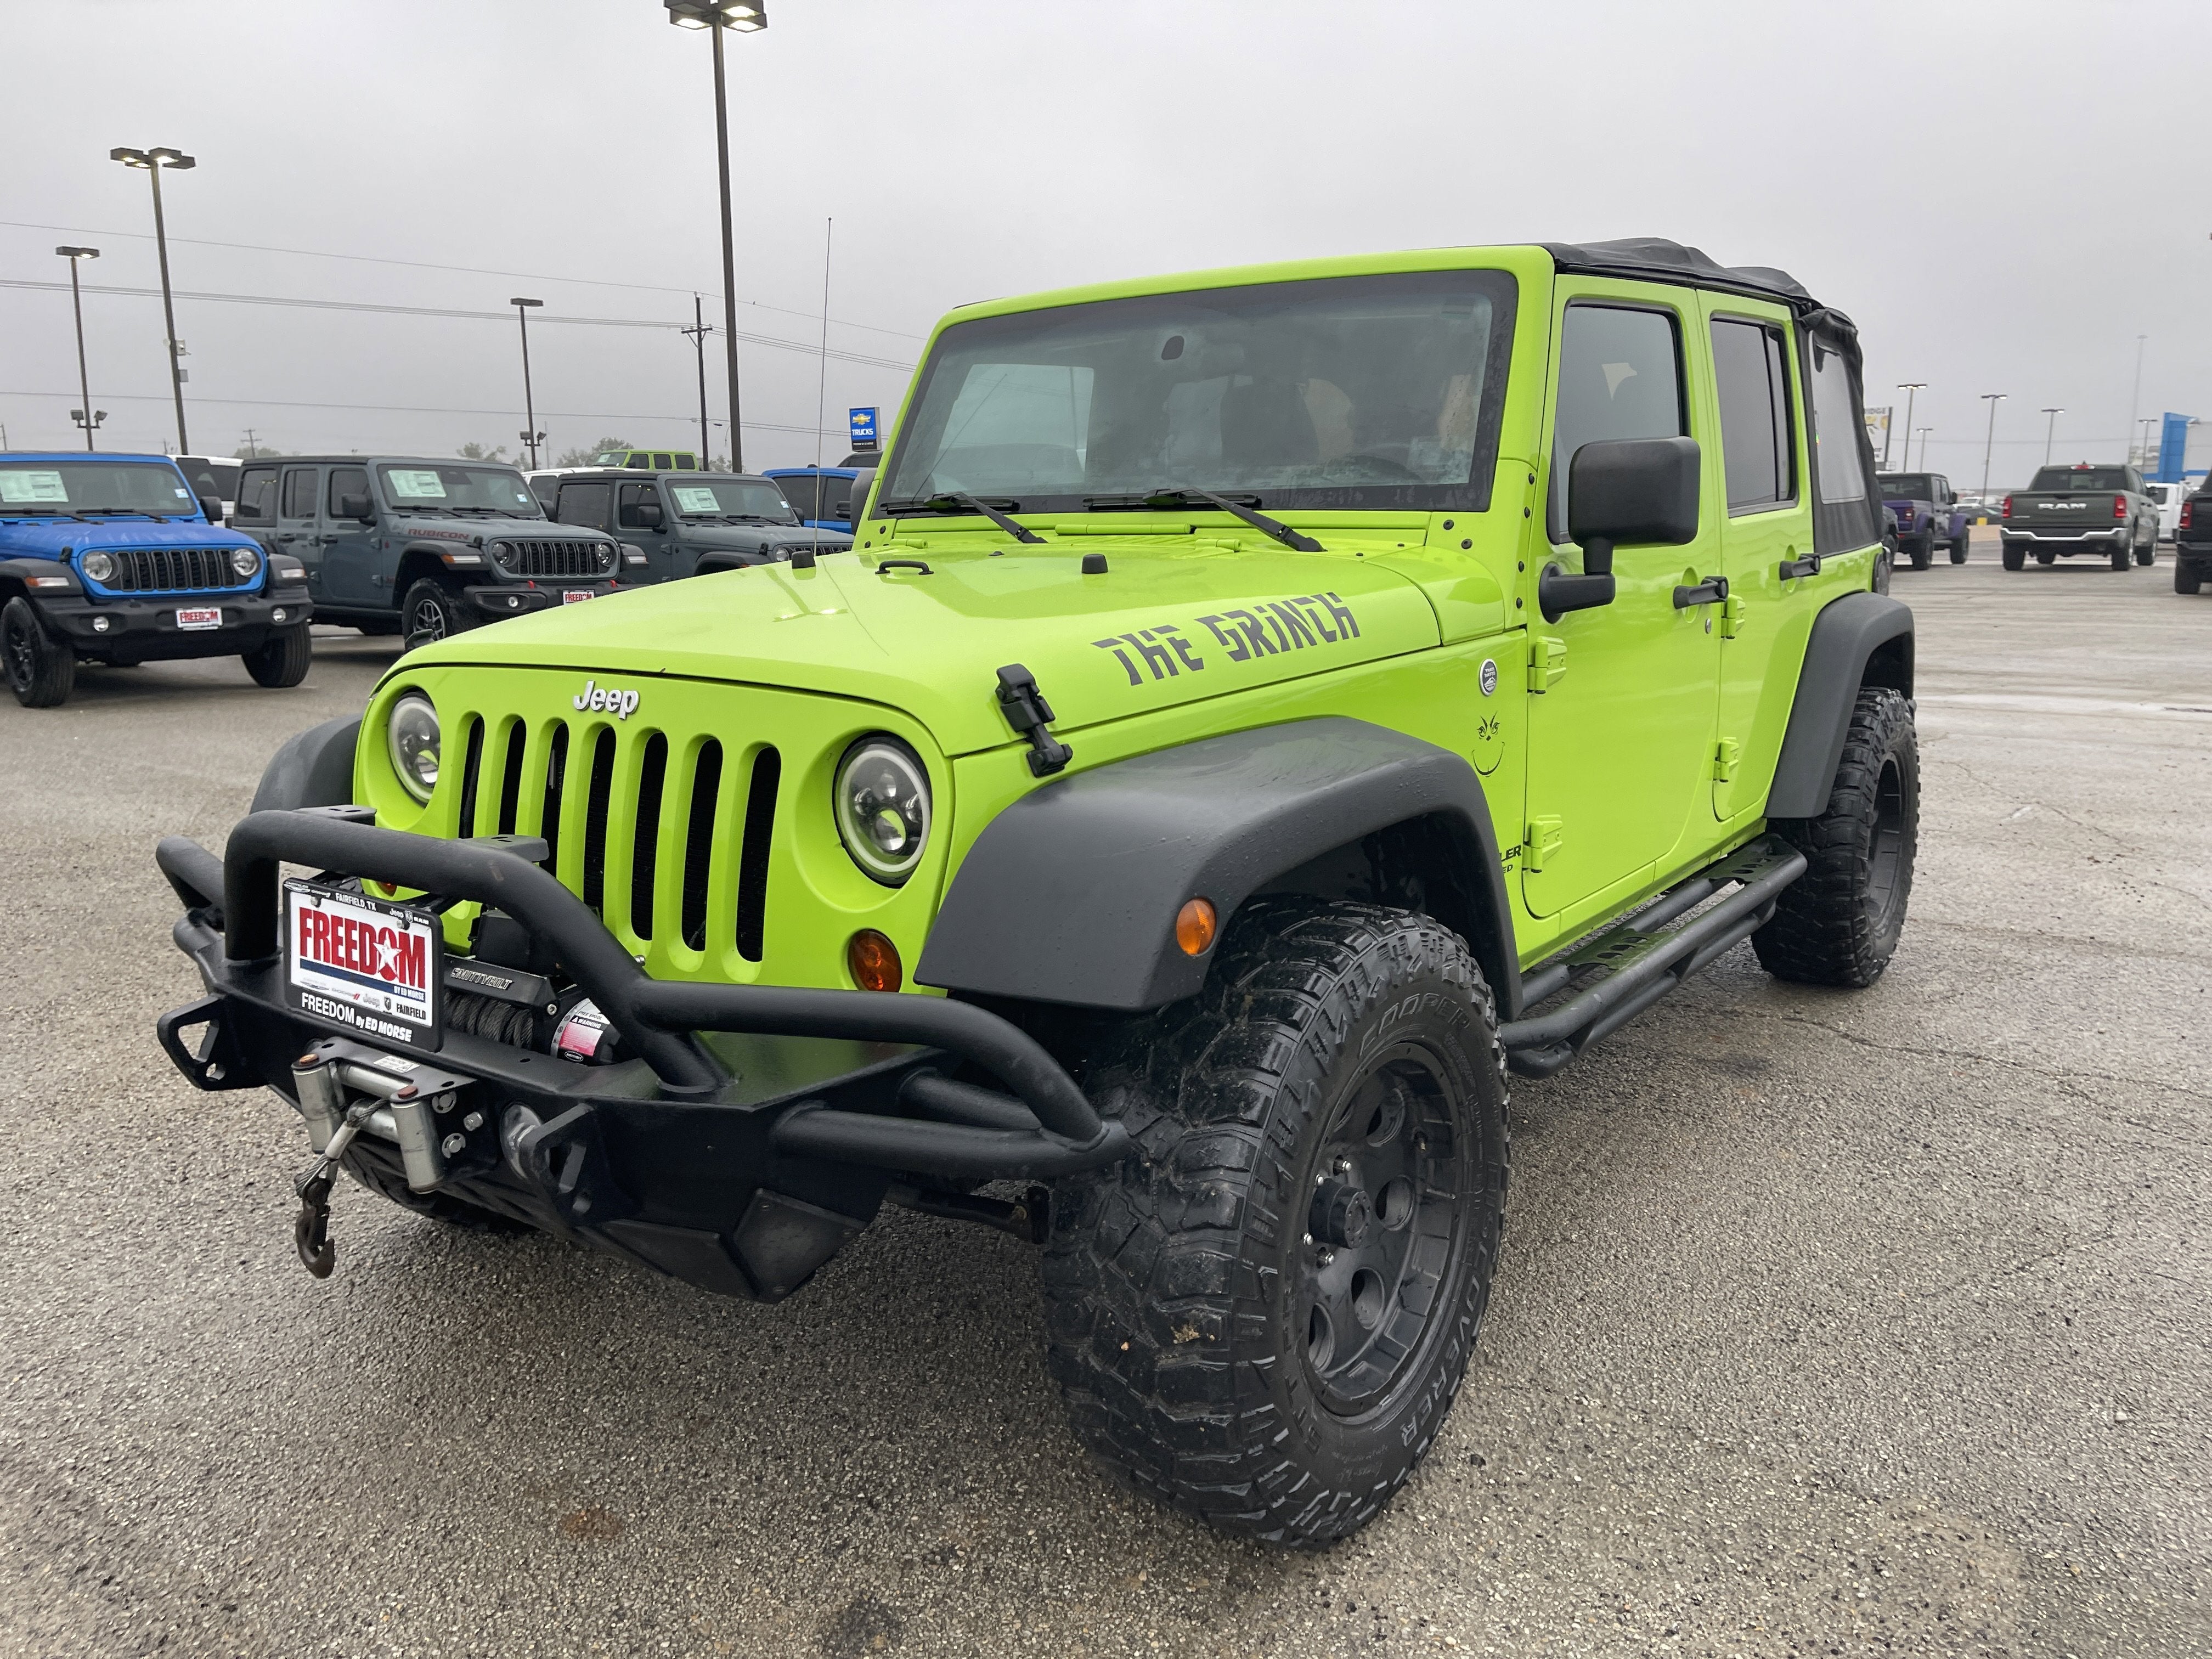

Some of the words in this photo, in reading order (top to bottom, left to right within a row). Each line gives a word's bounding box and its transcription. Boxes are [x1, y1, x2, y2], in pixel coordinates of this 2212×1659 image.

[408, 528, 470, 540] RUBICON
[1090, 624, 1204, 686] THE
[573, 680, 640, 720] Jeep
[1499, 844, 1521, 862] LER
[1503, 864, 1513, 874] ED
[366, 900, 376, 911] TX
[299, 906, 426, 990] FREEDOM
[450, 967, 513, 990] SMITTYBILT
[393, 985, 400, 994] BY
[400, 987, 407, 996] ED
[407, 988, 425, 1001] MORSE
[302, 992, 355, 1024] FREEDOM
[365, 1016, 378, 1031] ED
[377, 1020, 413, 1042] MORSE
[396, 1003, 426, 1020] FAIRFIELD
[578, 1018, 602, 1029] WARNING
[1357, 992, 1470, 1059] COOPER
